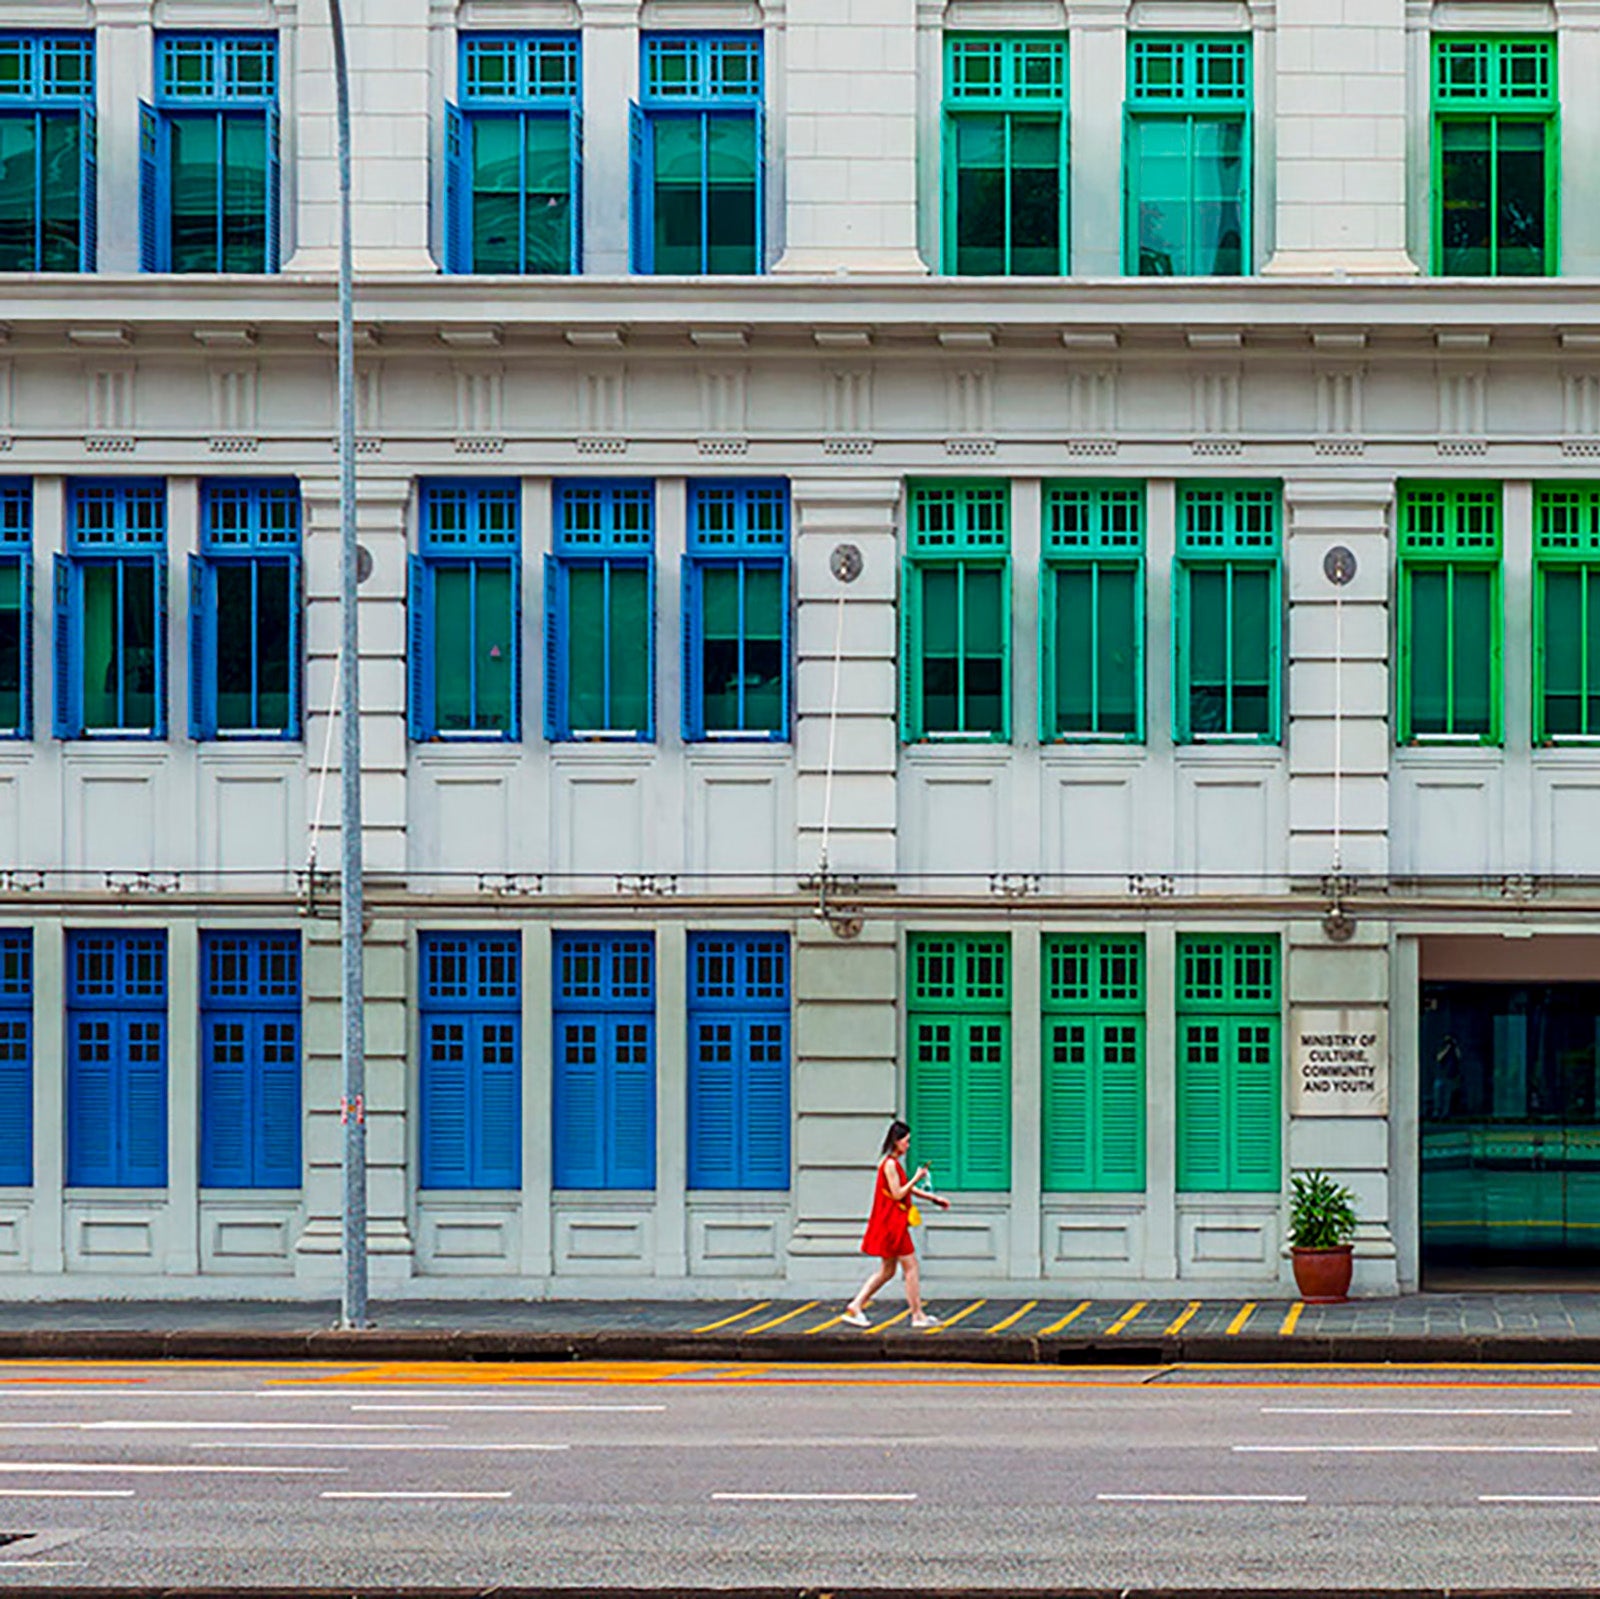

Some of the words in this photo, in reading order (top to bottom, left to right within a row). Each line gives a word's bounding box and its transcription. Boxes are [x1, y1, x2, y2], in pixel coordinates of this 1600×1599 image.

[1301, 1034, 1357, 1047] MINISTRY
[1360, 1034, 1377, 1047] OF
[1302, 1065, 1376, 1077] COMMUNITY
[1303, 1080, 1330, 1093] AND
[1332, 1080, 1375, 1093] YOUTH
